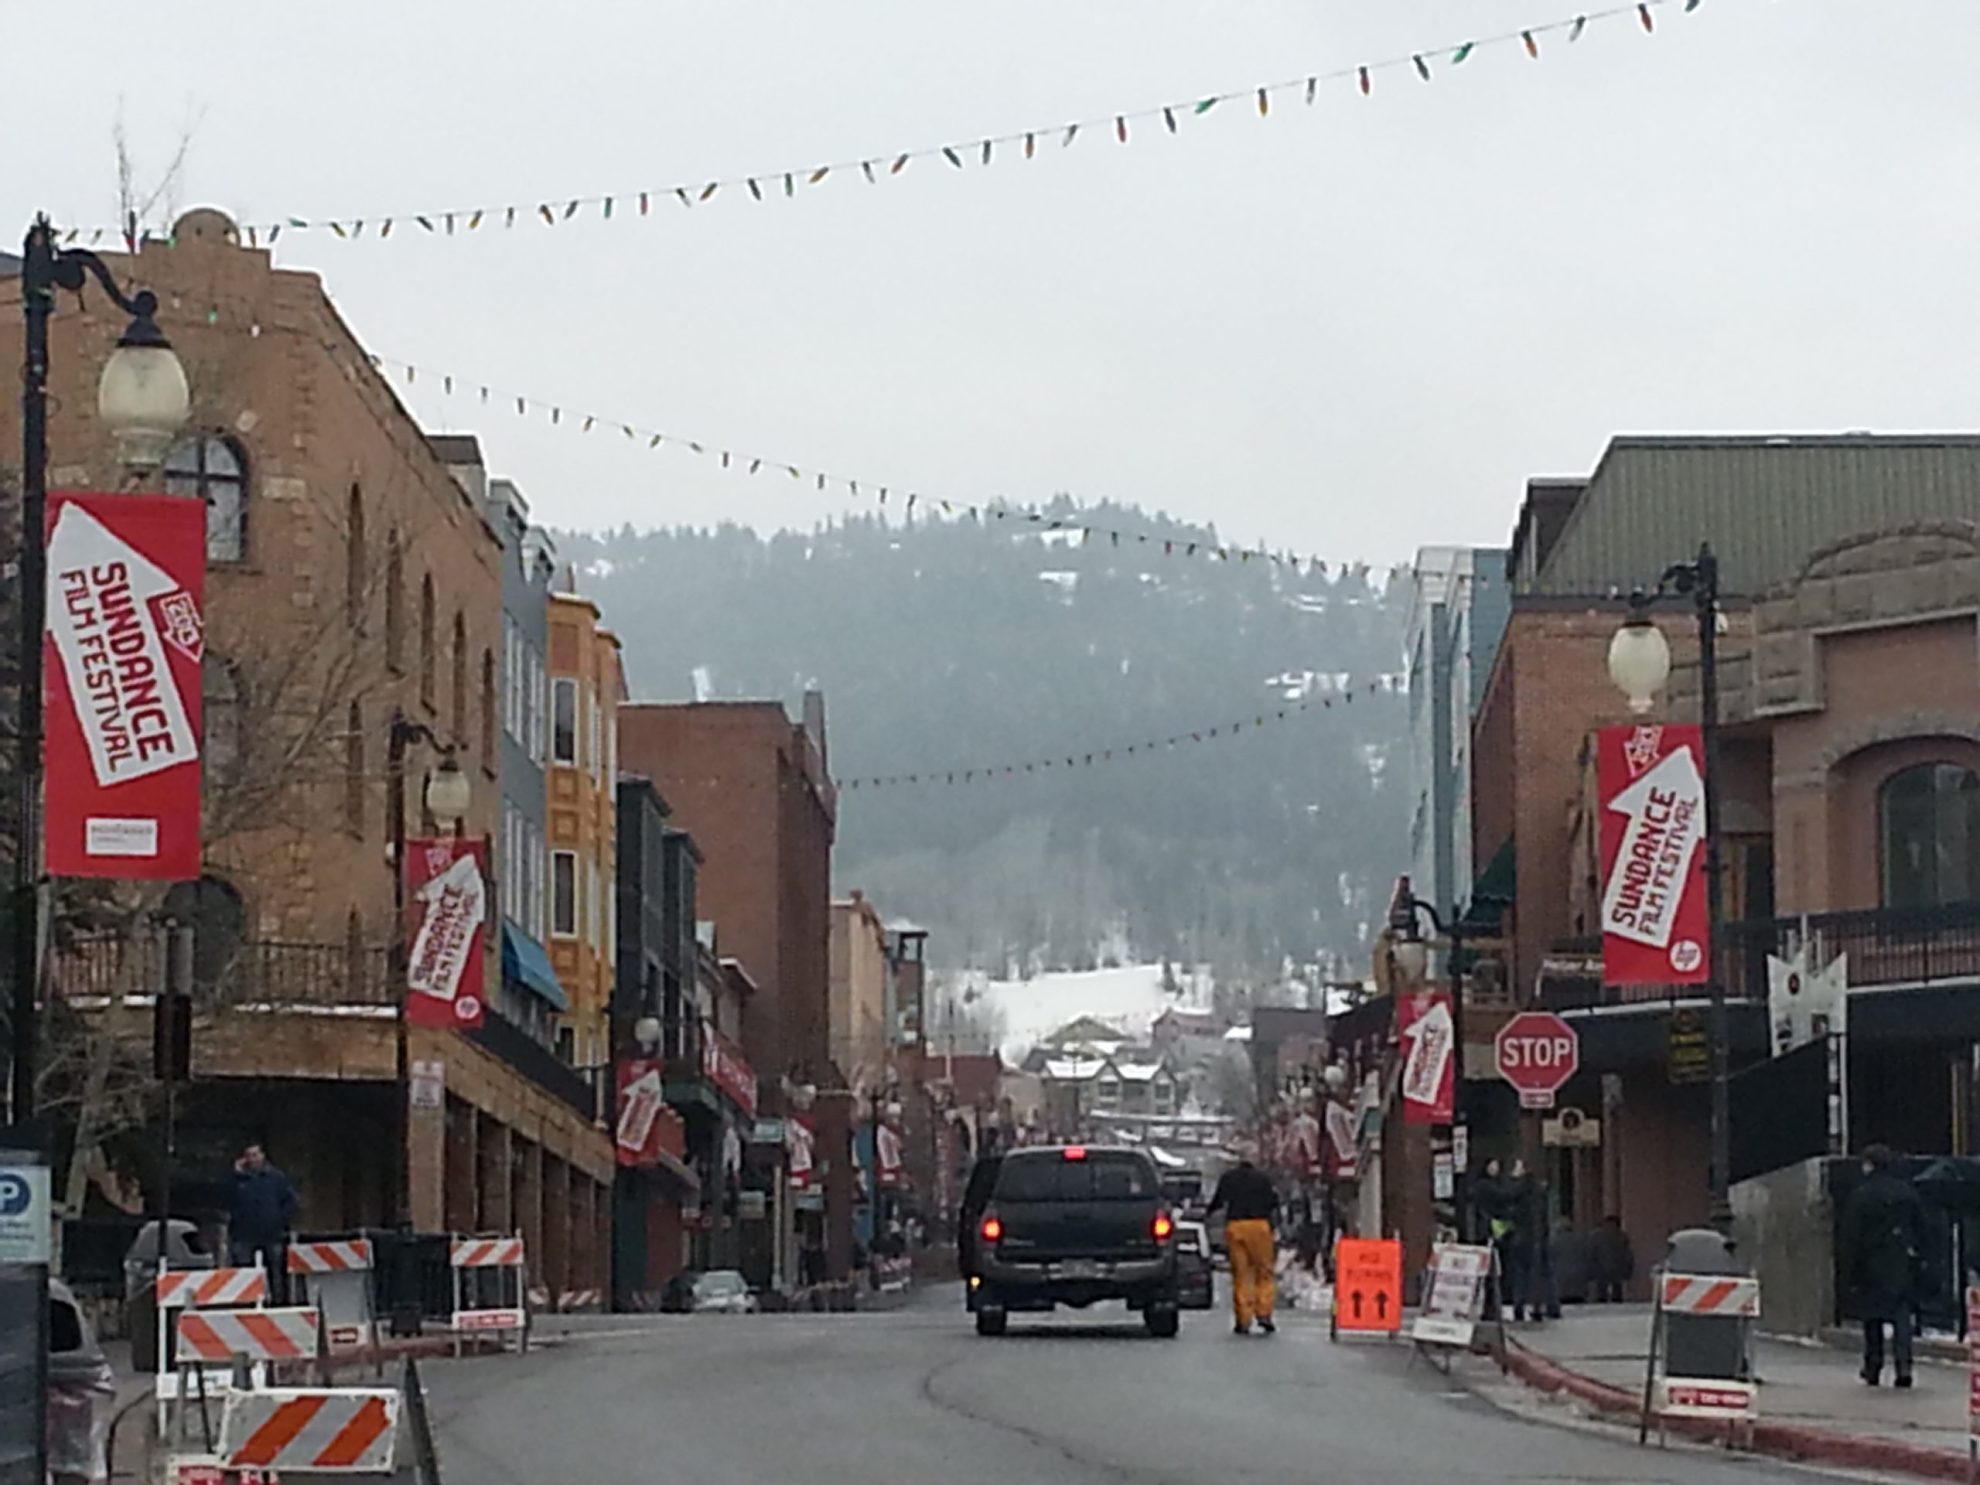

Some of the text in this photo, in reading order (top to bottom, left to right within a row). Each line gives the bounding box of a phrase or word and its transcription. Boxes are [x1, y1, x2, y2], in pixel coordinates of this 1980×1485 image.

[59, 569, 99, 630] FILM
[92, 561, 174, 763] SUNDANCE
[77, 634, 133, 773] FESTIVAL
[1611, 786, 1677, 928] SUNDANCE
[1638, 796, 1699, 937] FILM FESTIVAL
[1503, 1038, 1571, 1067] STOP
